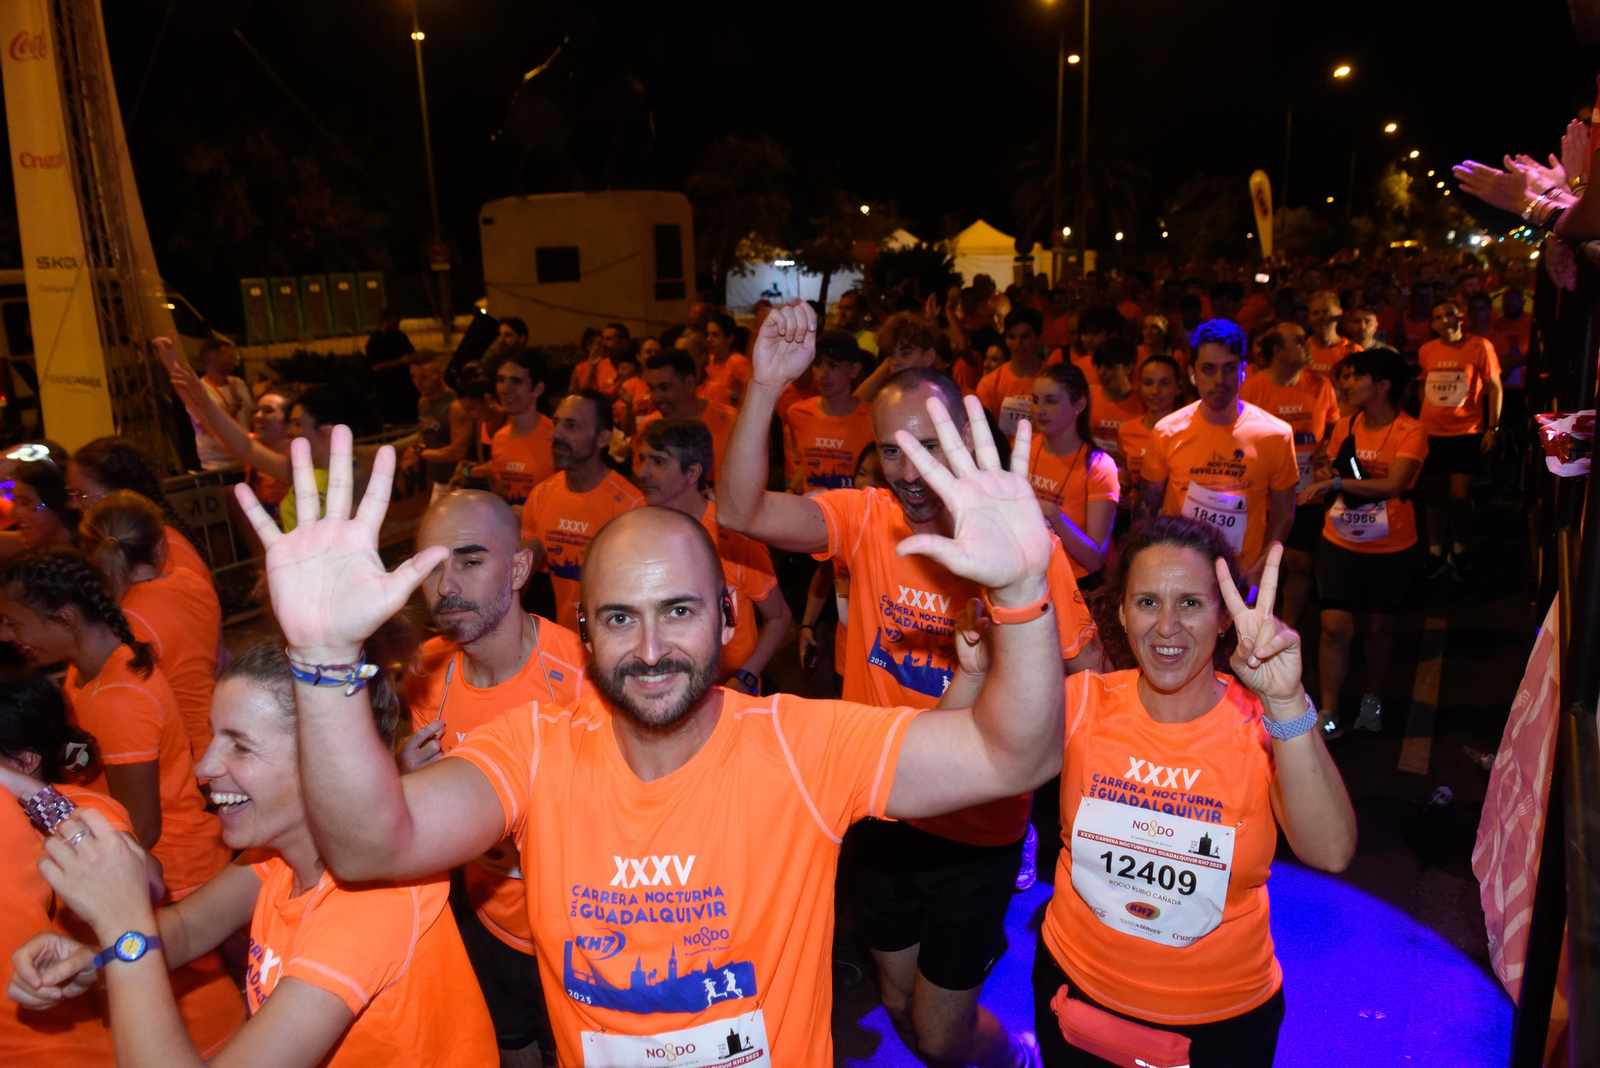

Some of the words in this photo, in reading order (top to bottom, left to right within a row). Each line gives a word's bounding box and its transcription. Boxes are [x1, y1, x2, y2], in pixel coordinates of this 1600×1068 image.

[815, 437, 844, 449] XXXV
[1207, 461, 1247, 470] NOCTURNA
[558, 518, 590, 534] XXXV
[1193, 506, 1236, 527] 18430
[1340, 513, 1377, 524] 13986
[881, 594, 915, 618] CARRERA
[897, 585, 952, 615] XXXV
[1123, 756, 1202, 790] XXXV
[1089, 783, 1098, 797] DEL
[1092, 773, 1147, 795] CARRERA
[1151, 789, 1224, 809] NOCTURNA
[1098, 787, 1222, 823] GUADALQUIVIR
[1080, 831, 1095, 840] XXXV
[1095, 835, 1119, 845] CARRERA
[1119, 840, 1148, 852] NOCTURNA
[1148, 847, 1158, 855] DEL
[1158, 849, 1198, 864] GUADALQUIVIR
[1198, 858, 1209, 866] KH7
[1209, 861, 1223, 869] 2023
[609, 855, 696, 889] XXXV
[1100, 850, 1198, 896] 12409
[572, 884, 639, 907] CARRERA
[645, 885, 725, 904] NOCTURNA
[1109, 879, 1131, 890] ROCIO
[1131, 885, 1152, 897] RUBIO
[1152, 890, 1182, 906] CAÑADA
[570, 898, 578, 918] DEL
[580, 901, 728, 925] GUADALQUIVIR
[567, 988, 592, 1005] 2023
[746, 1051, 760, 1063] 2023
